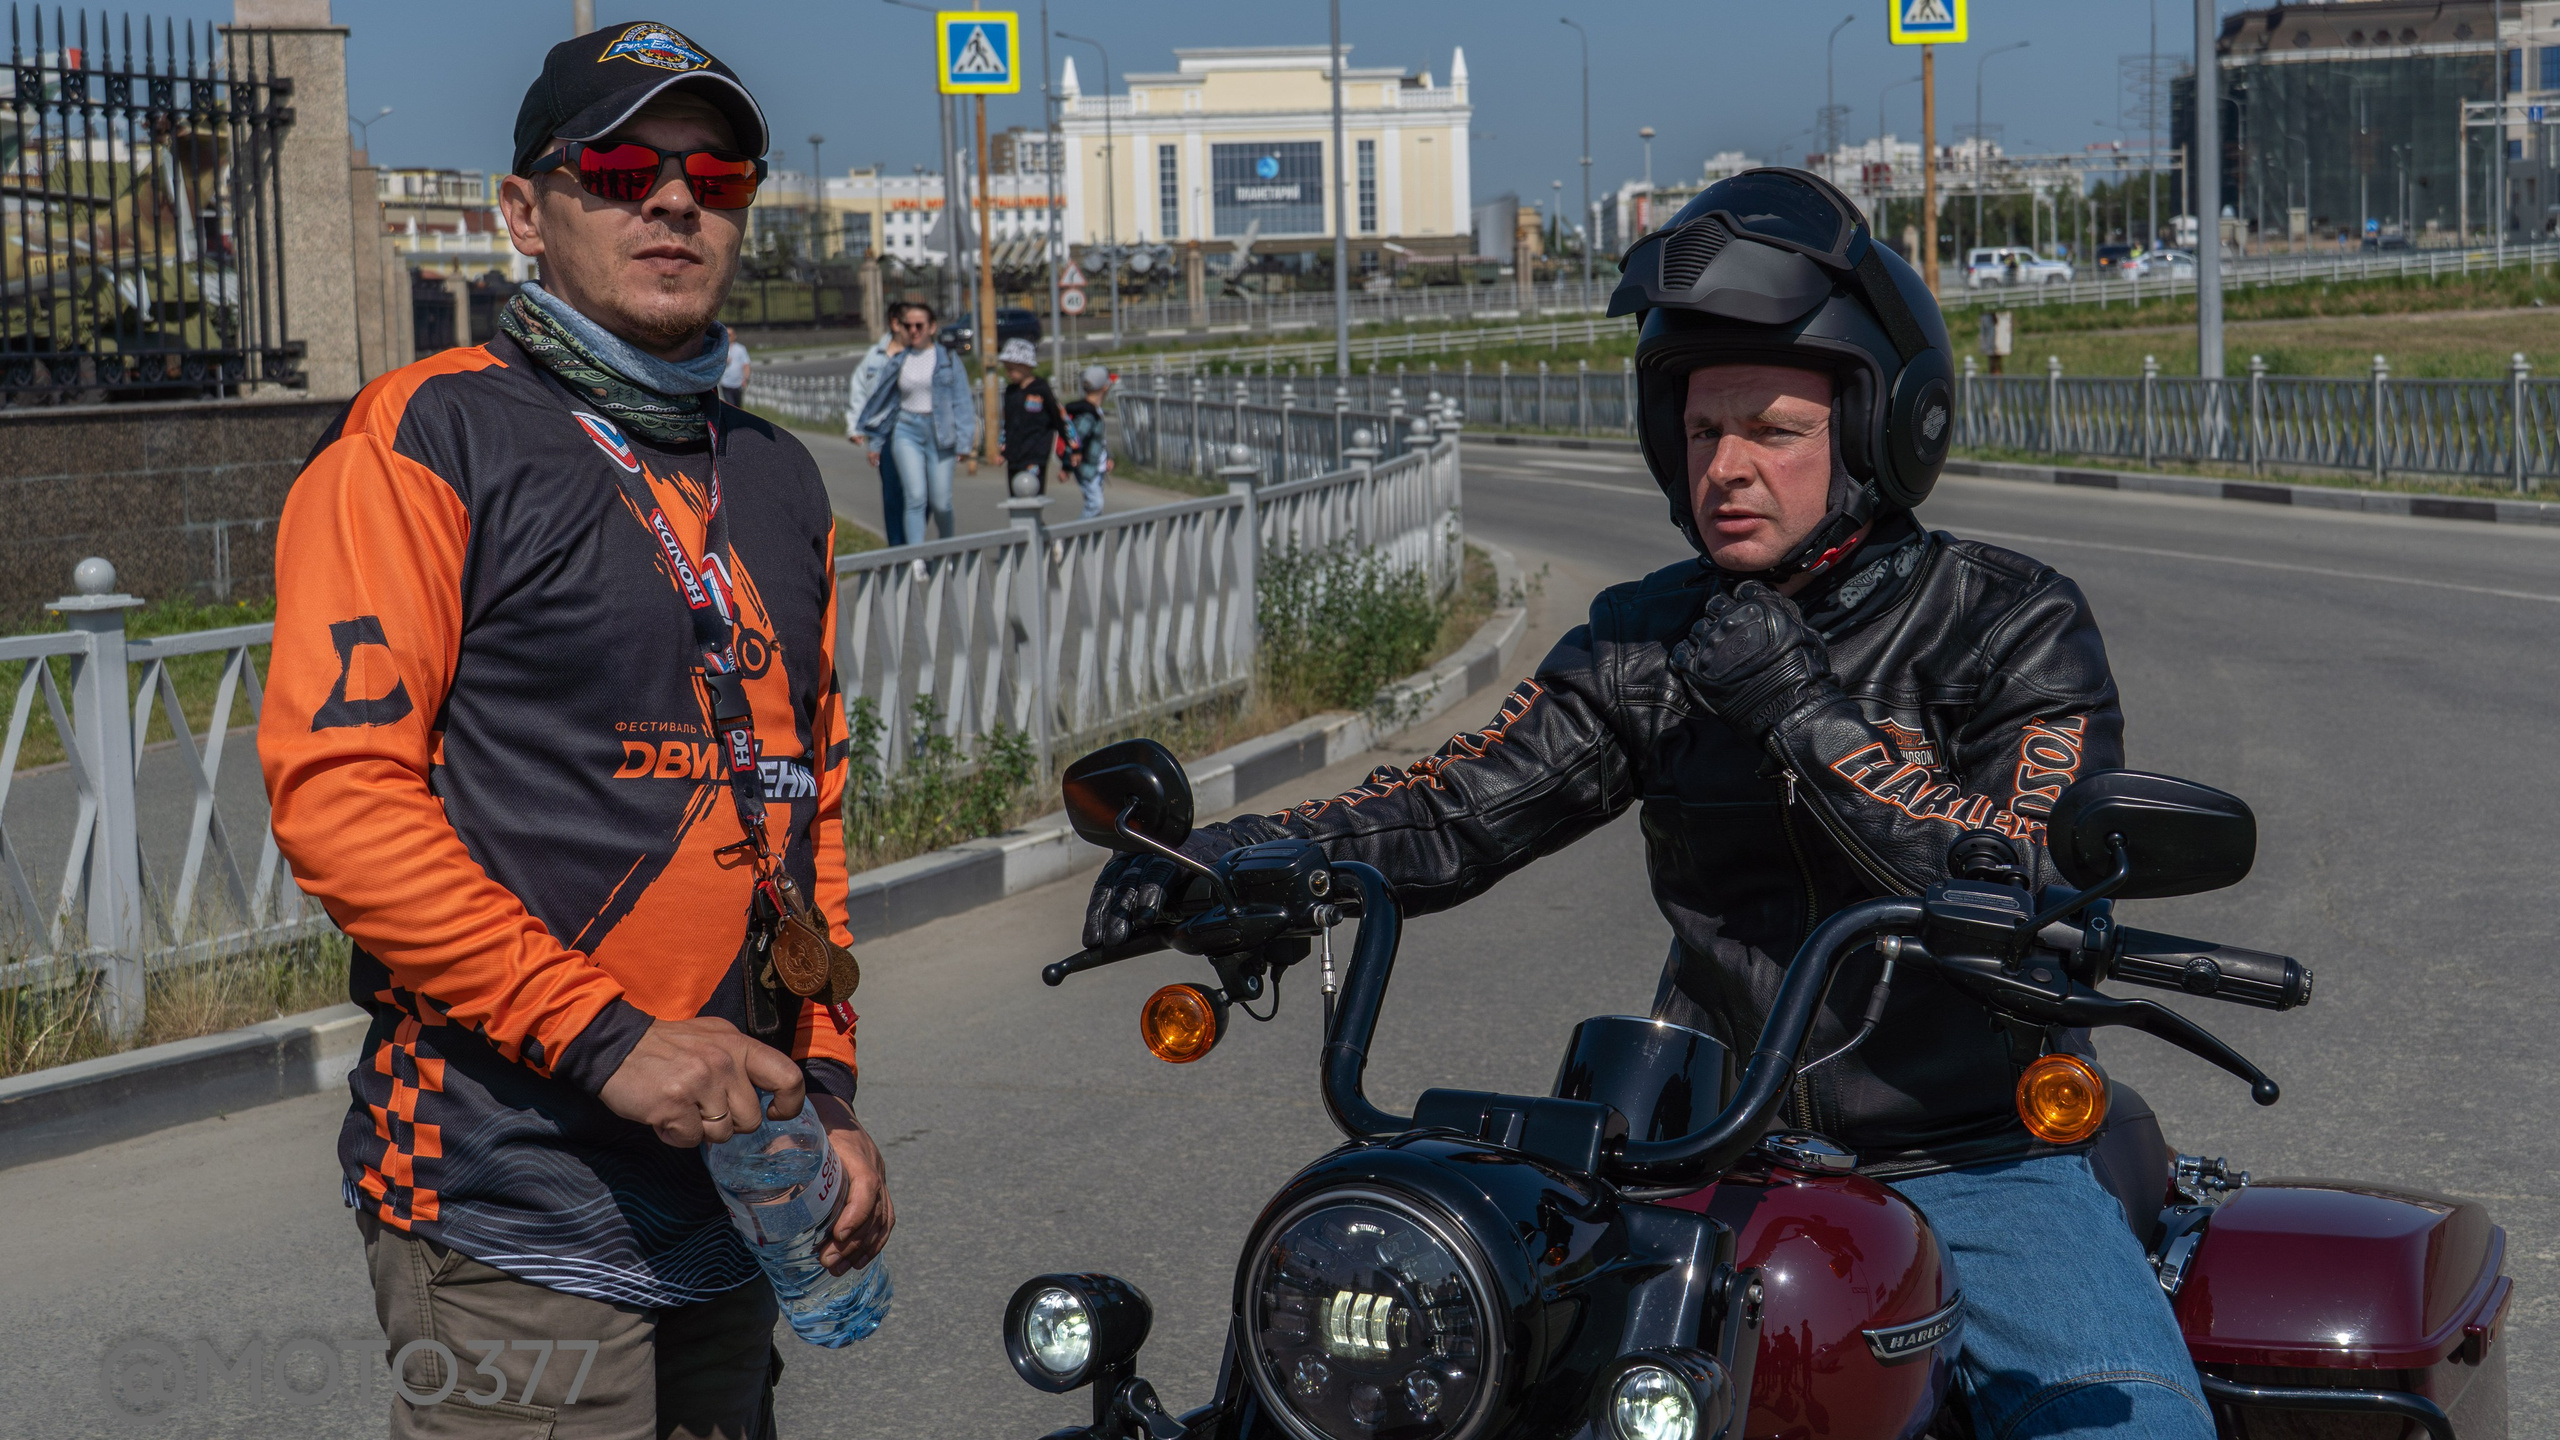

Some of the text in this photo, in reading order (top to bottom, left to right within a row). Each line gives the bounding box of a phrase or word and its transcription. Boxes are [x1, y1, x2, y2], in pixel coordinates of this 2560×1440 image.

[1235, 183, 1301, 201] ПЛАНЕТАРИЙ
[653, 512, 706, 605] HONDA
[614, 721, 698, 735] ФЕСТИВАЛЬ
